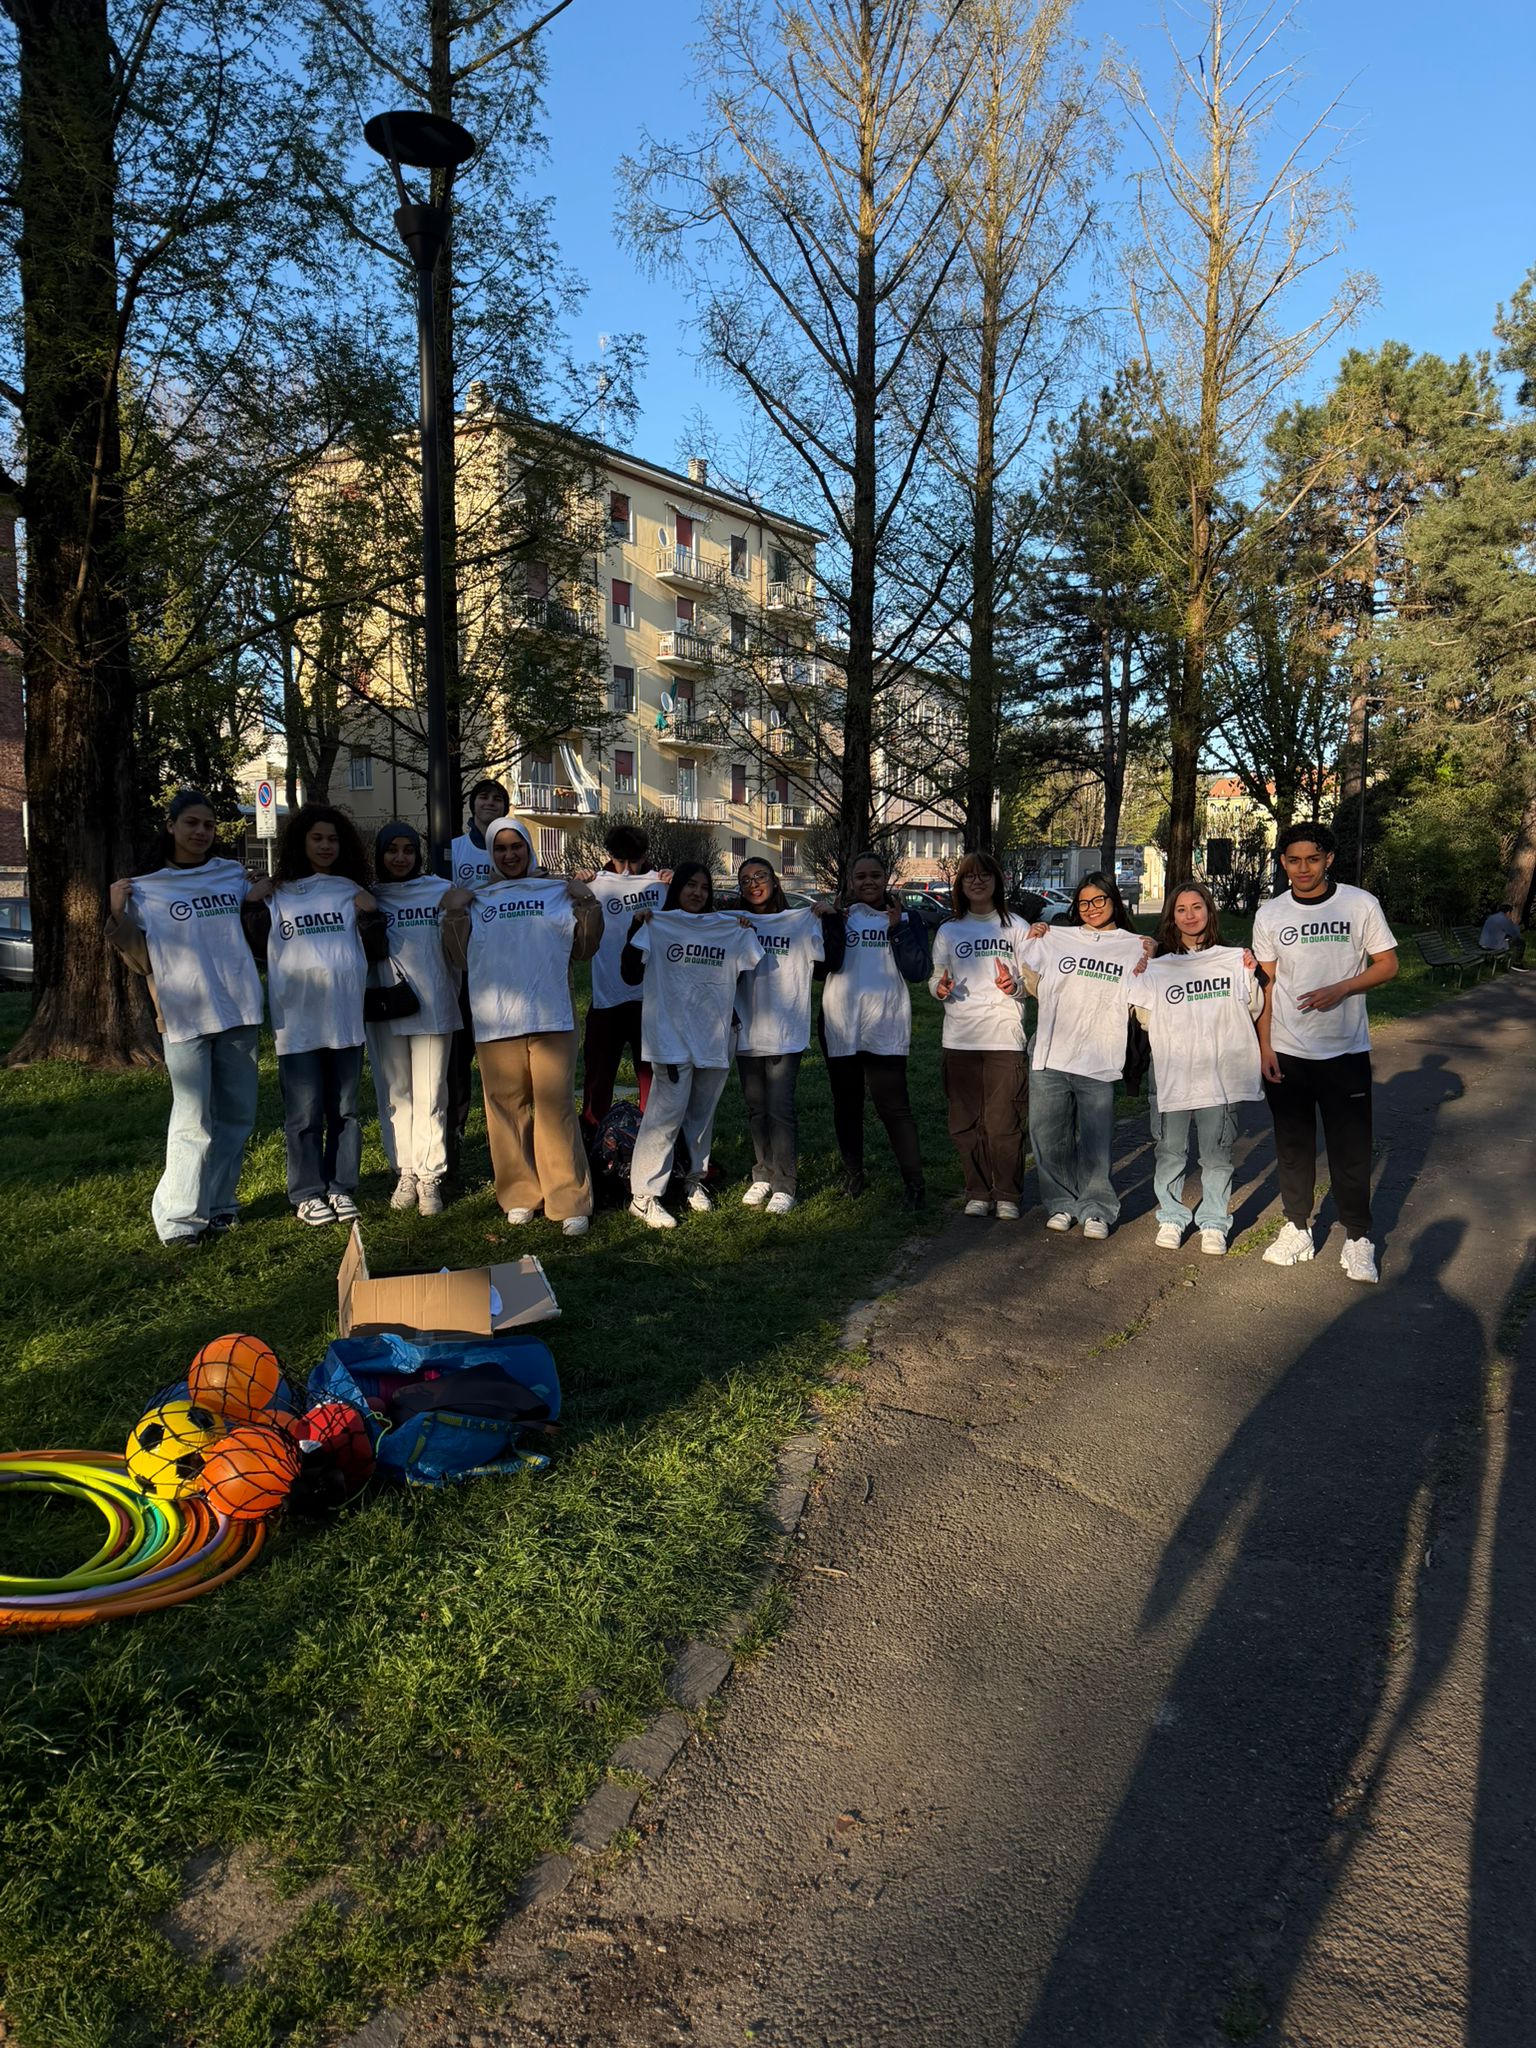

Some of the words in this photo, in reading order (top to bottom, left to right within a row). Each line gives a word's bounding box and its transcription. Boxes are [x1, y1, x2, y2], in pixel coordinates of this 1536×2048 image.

[192, 893, 239, 910] COACH
[623, 890, 660, 905] COACH
[499, 900, 545, 912] COACH
[397, 906, 440, 920] COACH
[507, 909, 545, 919] QUARTIERE
[295, 912, 344, 928] COACH
[297, 928, 305, 936] DI
[305, 925, 346, 935] QUARTIERE
[862, 928, 890, 941] COA
[1301, 921, 1351, 936] COACH
[757, 936, 791, 949] OACH
[1309, 935, 1350, 943] QUARTIERE
[686, 944, 726, 960] COACH
[974, 939, 1014, 953] COACH
[981, 950, 1013, 960] QUARTIERE
[691, 957, 724, 967] QUARTIERE
[1079, 957, 1123, 976] COACH
[1084, 971, 1120, 983] QUARTIERE
[1186, 977, 1231, 994] COACH
[1194, 990, 1231, 1000] QUARTIERE
